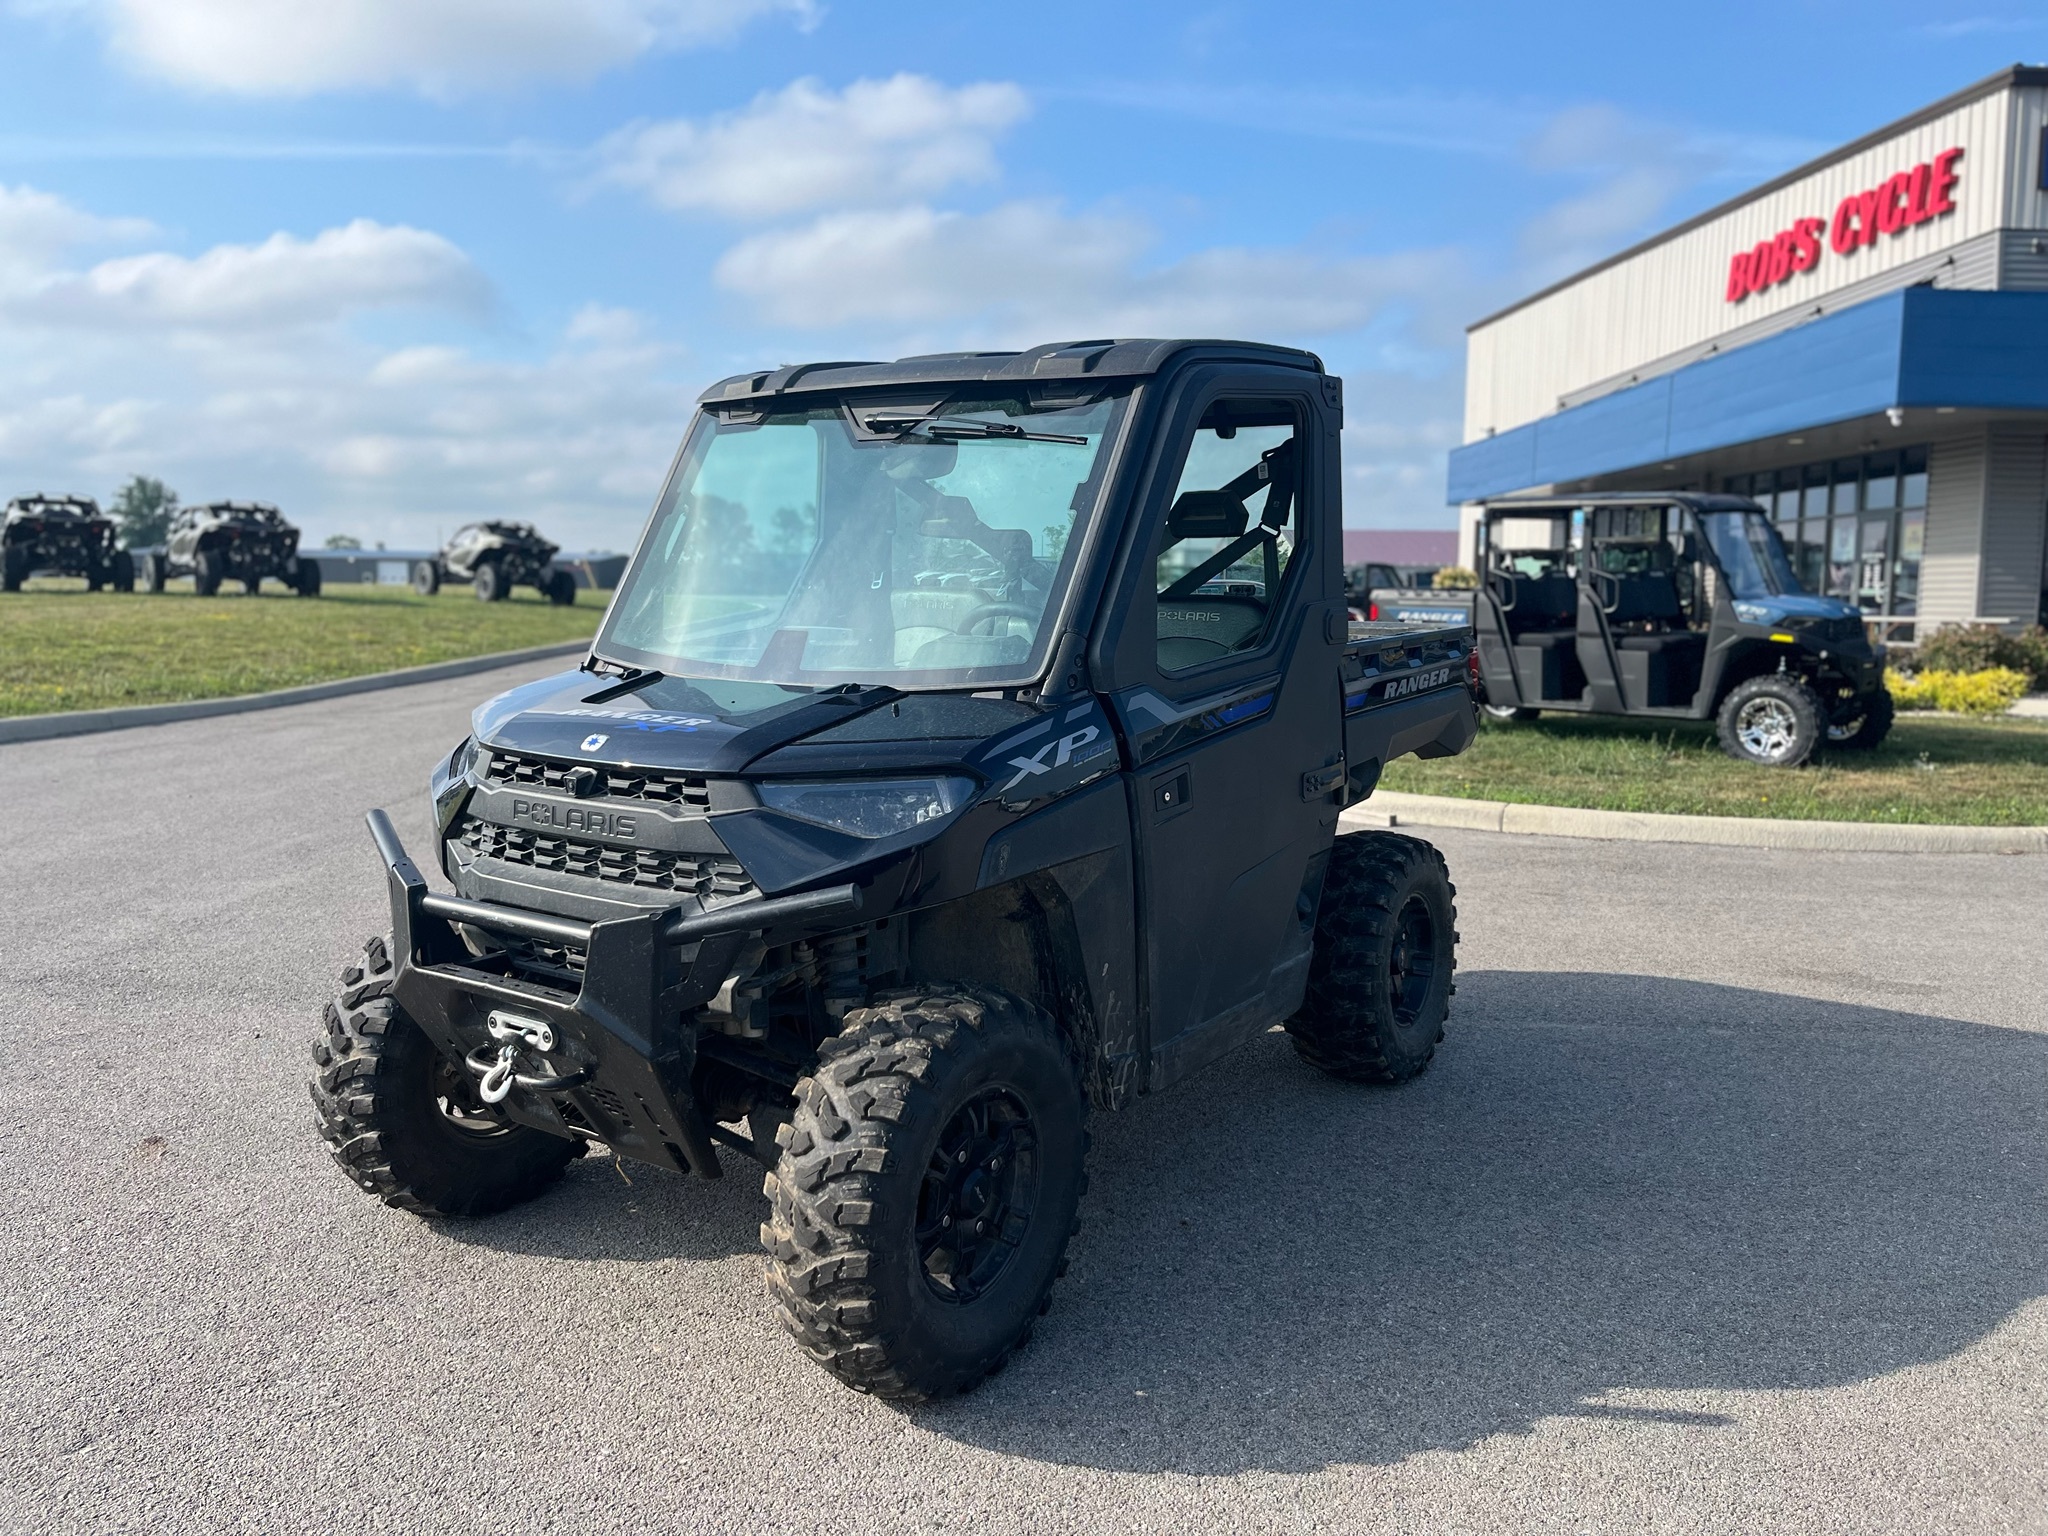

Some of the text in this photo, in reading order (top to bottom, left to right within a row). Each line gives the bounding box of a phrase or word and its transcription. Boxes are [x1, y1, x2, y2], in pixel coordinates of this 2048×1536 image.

[1726, 147, 1965, 303] BOB'S CYCLE
[1157, 611, 1220, 622] POLARIS
[1397, 611, 1465, 622] RANGER
[1384, 668, 1450, 700] RANGER
[556, 708, 712, 727] RANGER
[614, 721, 699, 733] XP
[999, 725, 1100, 793] XP
[1072, 740, 1112, 764] 1000
[513, 799, 638, 840] POLARIS
